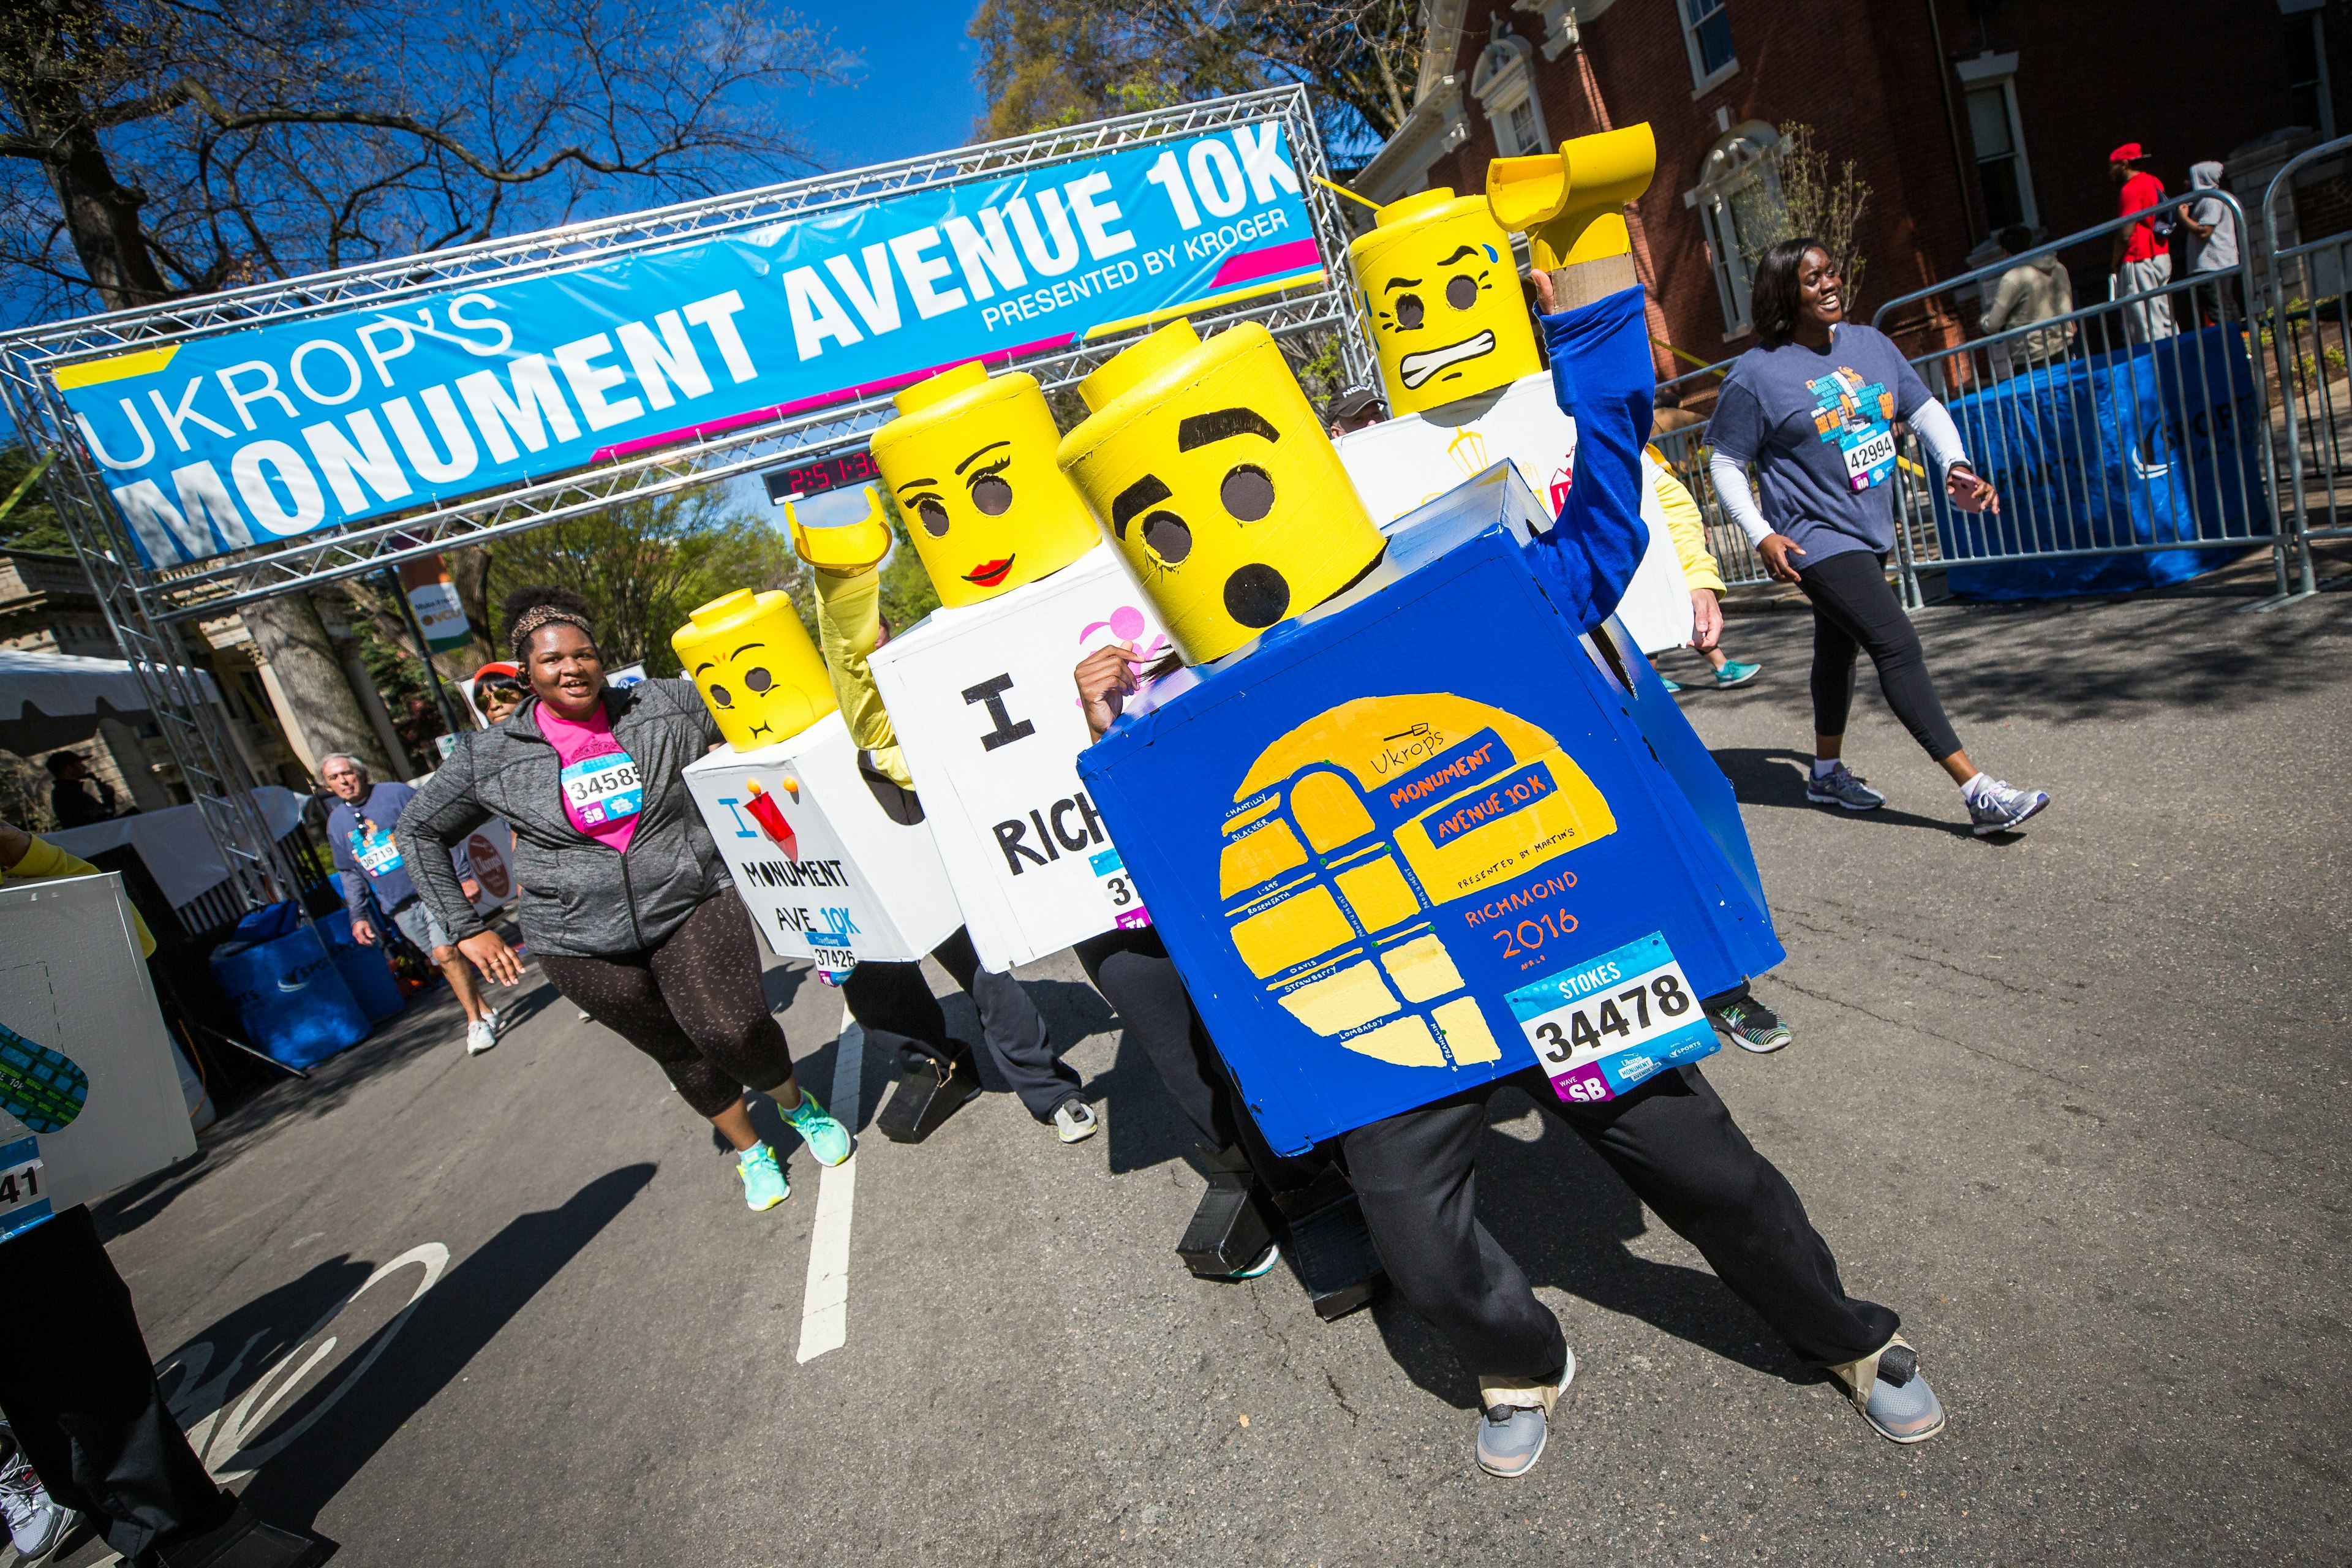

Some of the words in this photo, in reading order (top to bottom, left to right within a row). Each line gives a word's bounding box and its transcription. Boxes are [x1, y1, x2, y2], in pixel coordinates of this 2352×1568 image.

[981, 260, 1139, 332] PRESENTED
[1142, 244, 1177, 274] BY
[1183, 208, 1288, 262] KROGER
[113, 289, 758, 567] MONUMENT
[783, 171, 1137, 361] AVENUE
[1146, 120, 1301, 230] 10K
[74, 293, 513, 470] UKROP'S
[1852, 436, 1893, 469] 42994
[961, 673, 1035, 752] I
[1390, 742, 1493, 809] MONUMENT
[584, 807, 605, 824] SB
[717, 798, 758, 838] I
[1225, 793, 1267, 818] CHANTILLY
[1438, 792, 1505, 839] AVENUE
[1504, 774, 1547, 805] 10K
[1231, 818, 1269, 842] BLACKER
[741, 860, 850, 887] MONUMENT
[1457, 858, 1513, 889] PRESENTED
[1520, 849, 1530, 859] BY
[1534, 827, 1575, 853] MARTIN'S
[1464, 871, 1578, 928] RICHMOND
[775, 907, 817, 932] AVE
[820, 907, 861, 934] 10K
[1493, 908, 1579, 959] 2016
[815, 949, 856, 967] 37426
[1558, 961, 1621, 1000] STOKES
[1339, 1018, 1384, 1040] LOMBARDY
[1536, 974, 1689, 1063] 34478
[1430, 1023, 1452, 1058] FRANKLIN
[1676, 1041, 1702, 1054] SPORTS
[1559, 1076, 1577, 1087] WAVE
[1621, 1060, 1650, 1077] MONUMENT
[1633, 1068, 1652, 1080] AVENUE
[1569, 1077, 1606, 1102] SB
